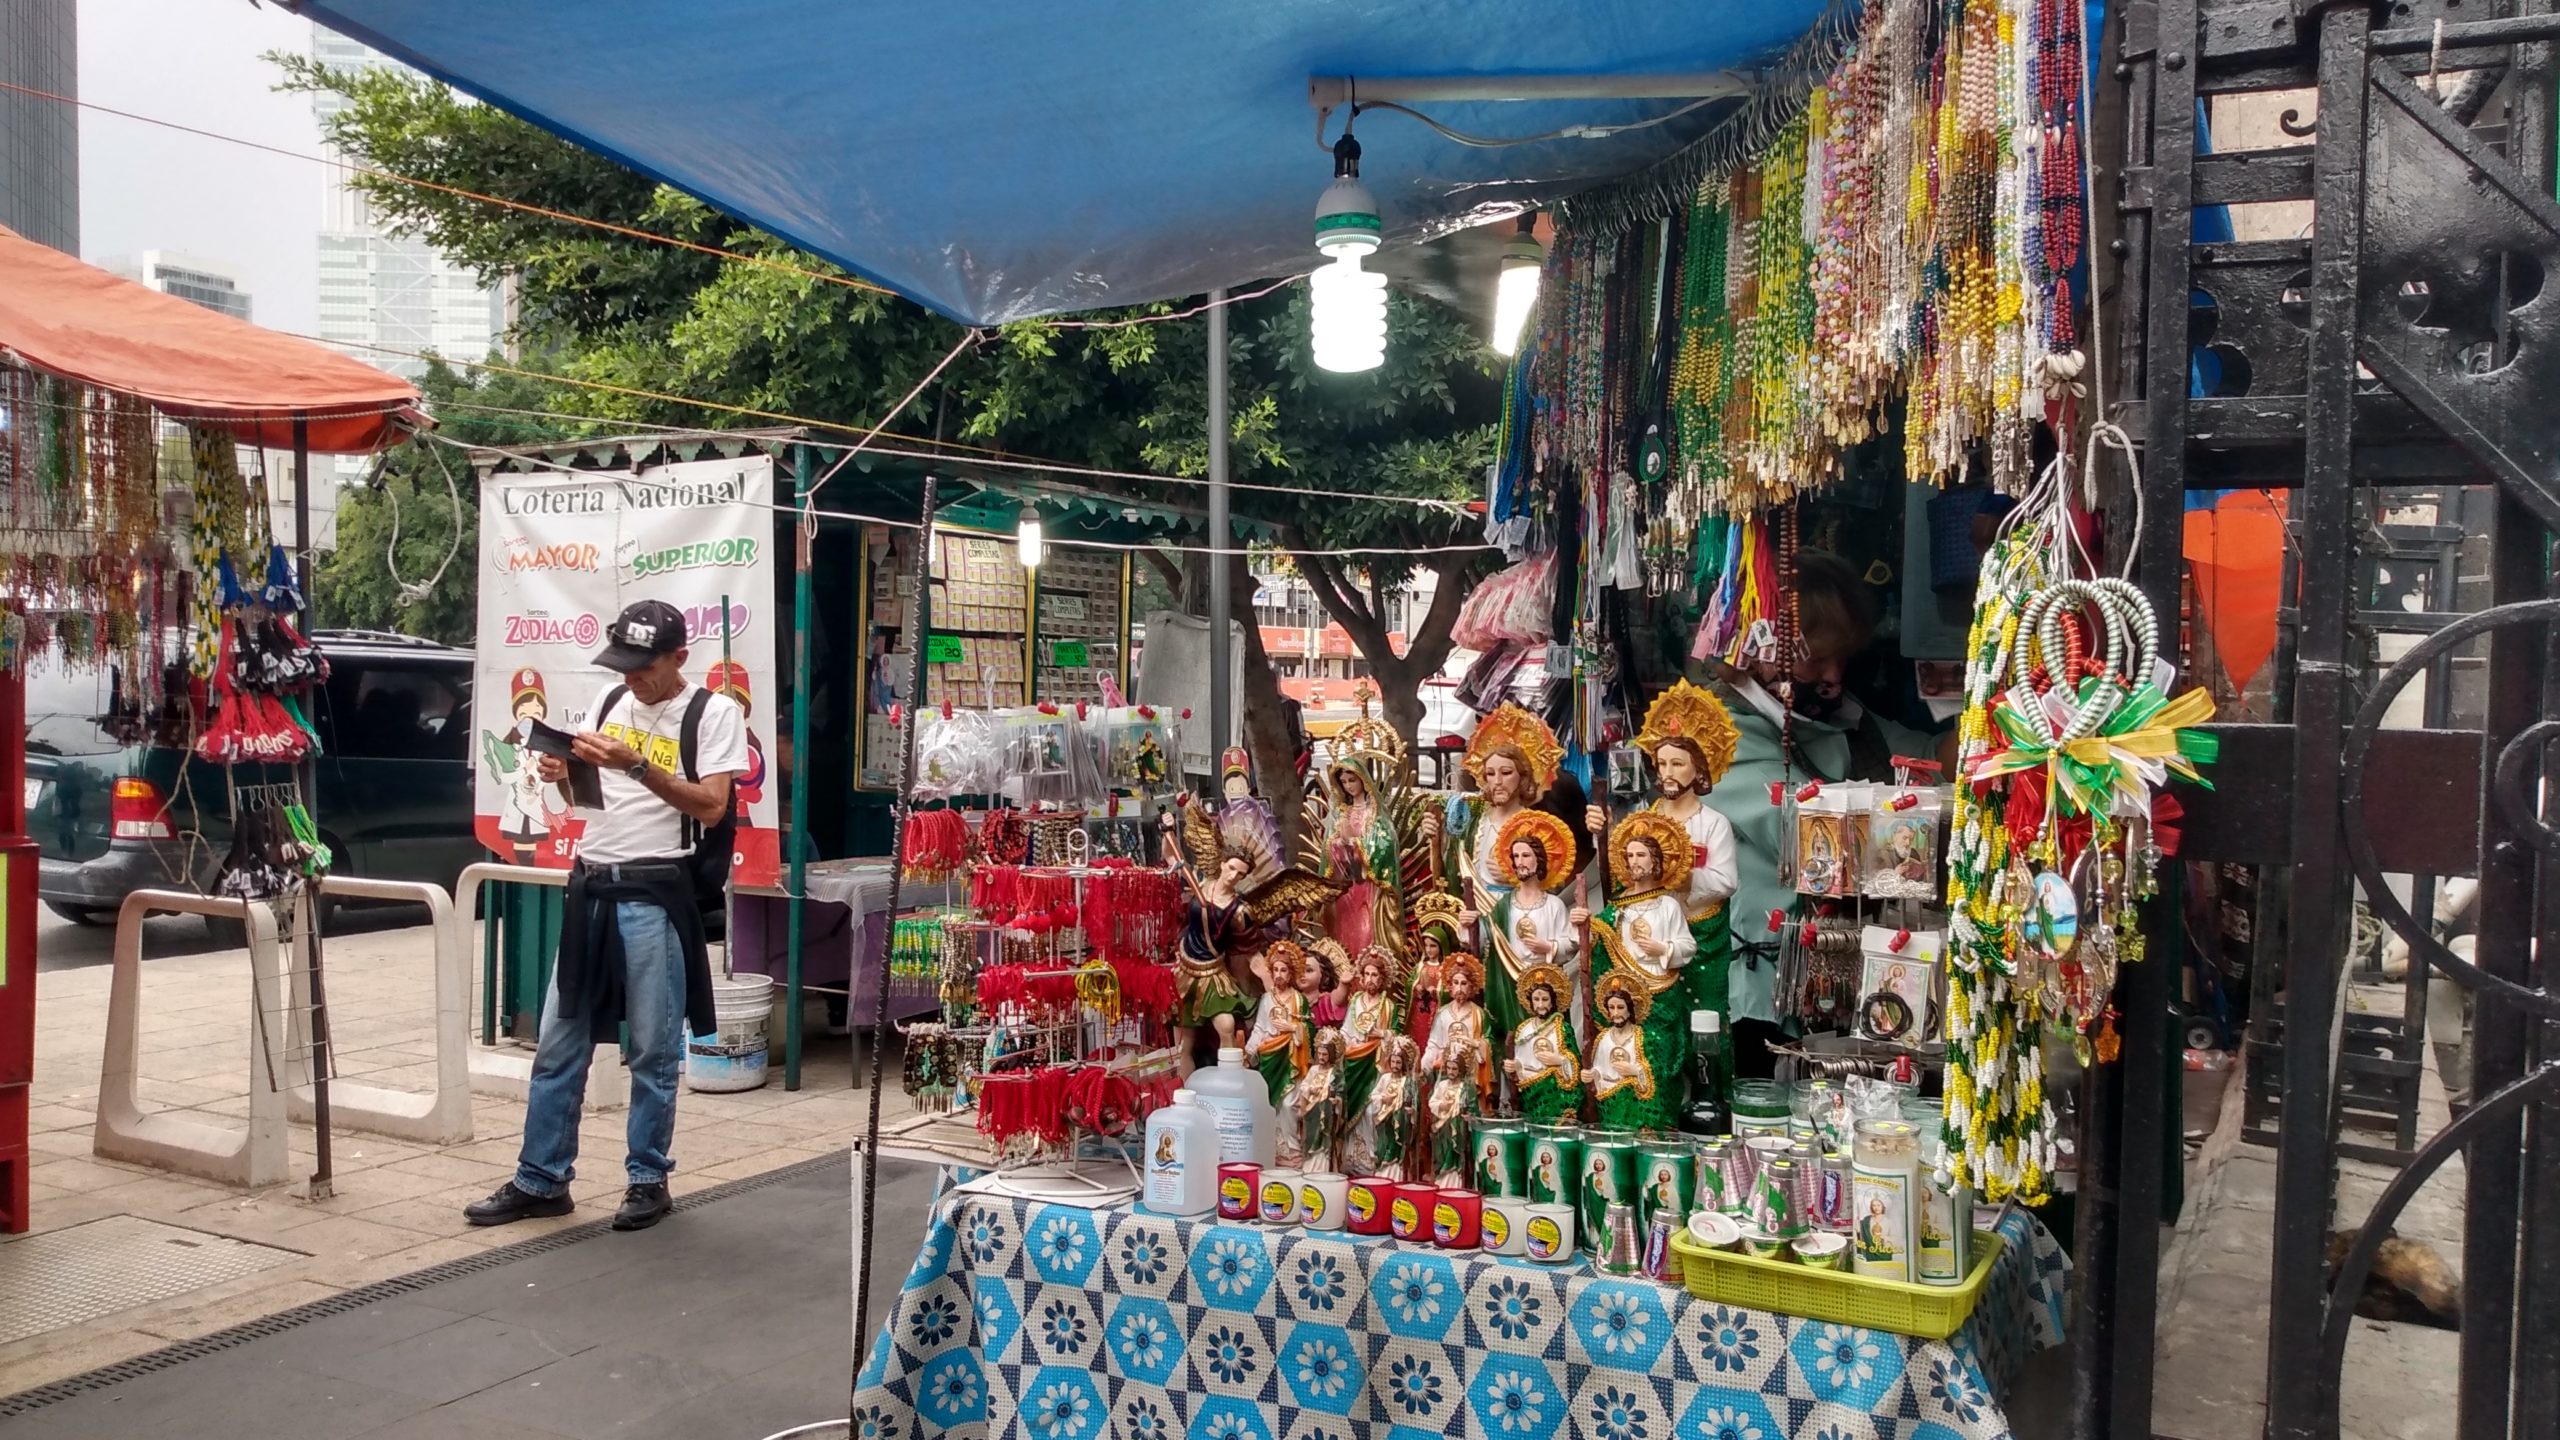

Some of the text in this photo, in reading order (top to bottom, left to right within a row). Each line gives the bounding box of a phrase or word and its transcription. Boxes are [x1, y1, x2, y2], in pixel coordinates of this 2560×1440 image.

[503, 472, 745, 515] Lotería Nacional
[509, 543, 599, 572] MAYOR
[633, 538, 756, 576] SUPERIOR
[505, 613, 600, 647] ZODIACO
[944, 648, 961, 658] 20
[651, 750, 673, 767] Na
[554, 838, 569, 856] Si
